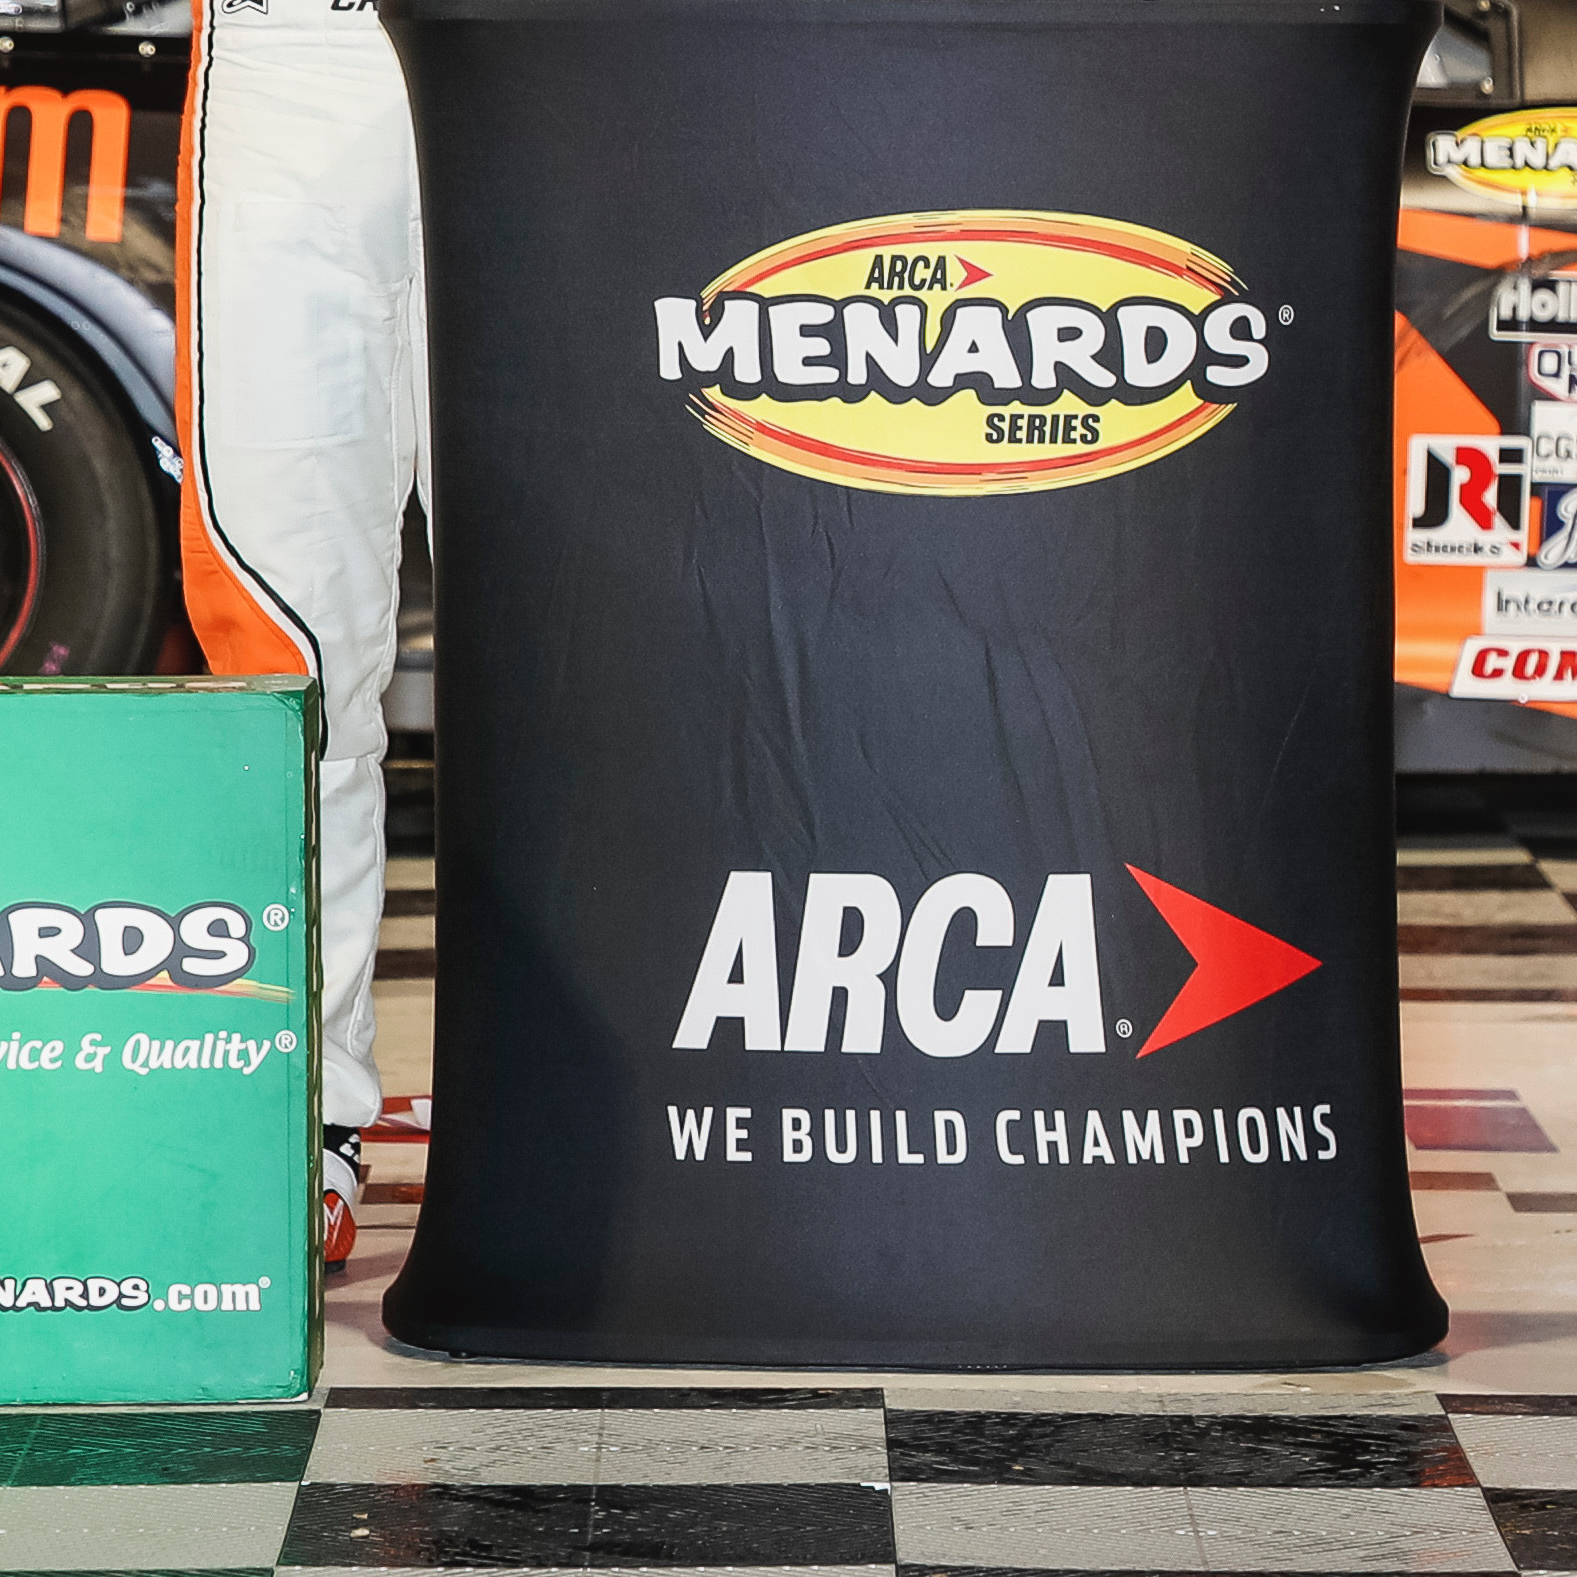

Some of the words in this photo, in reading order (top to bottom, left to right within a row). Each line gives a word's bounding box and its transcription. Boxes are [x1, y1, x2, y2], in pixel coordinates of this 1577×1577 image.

[865, 254, 949, 292] ARCA
[653, 296, 1269, 390] MENARDS
[985, 413, 1101, 446] SERIES
[671, 870, 1107, 1059] ARCA
[78, 1035, 111, 1073] &
[122, 1030, 271, 1076] Quality
[666, 1105, 754, 1165] WE
[781, 1107, 969, 1166] BUILD
[994, 1102, 1338, 1166] CHAMPIONS
